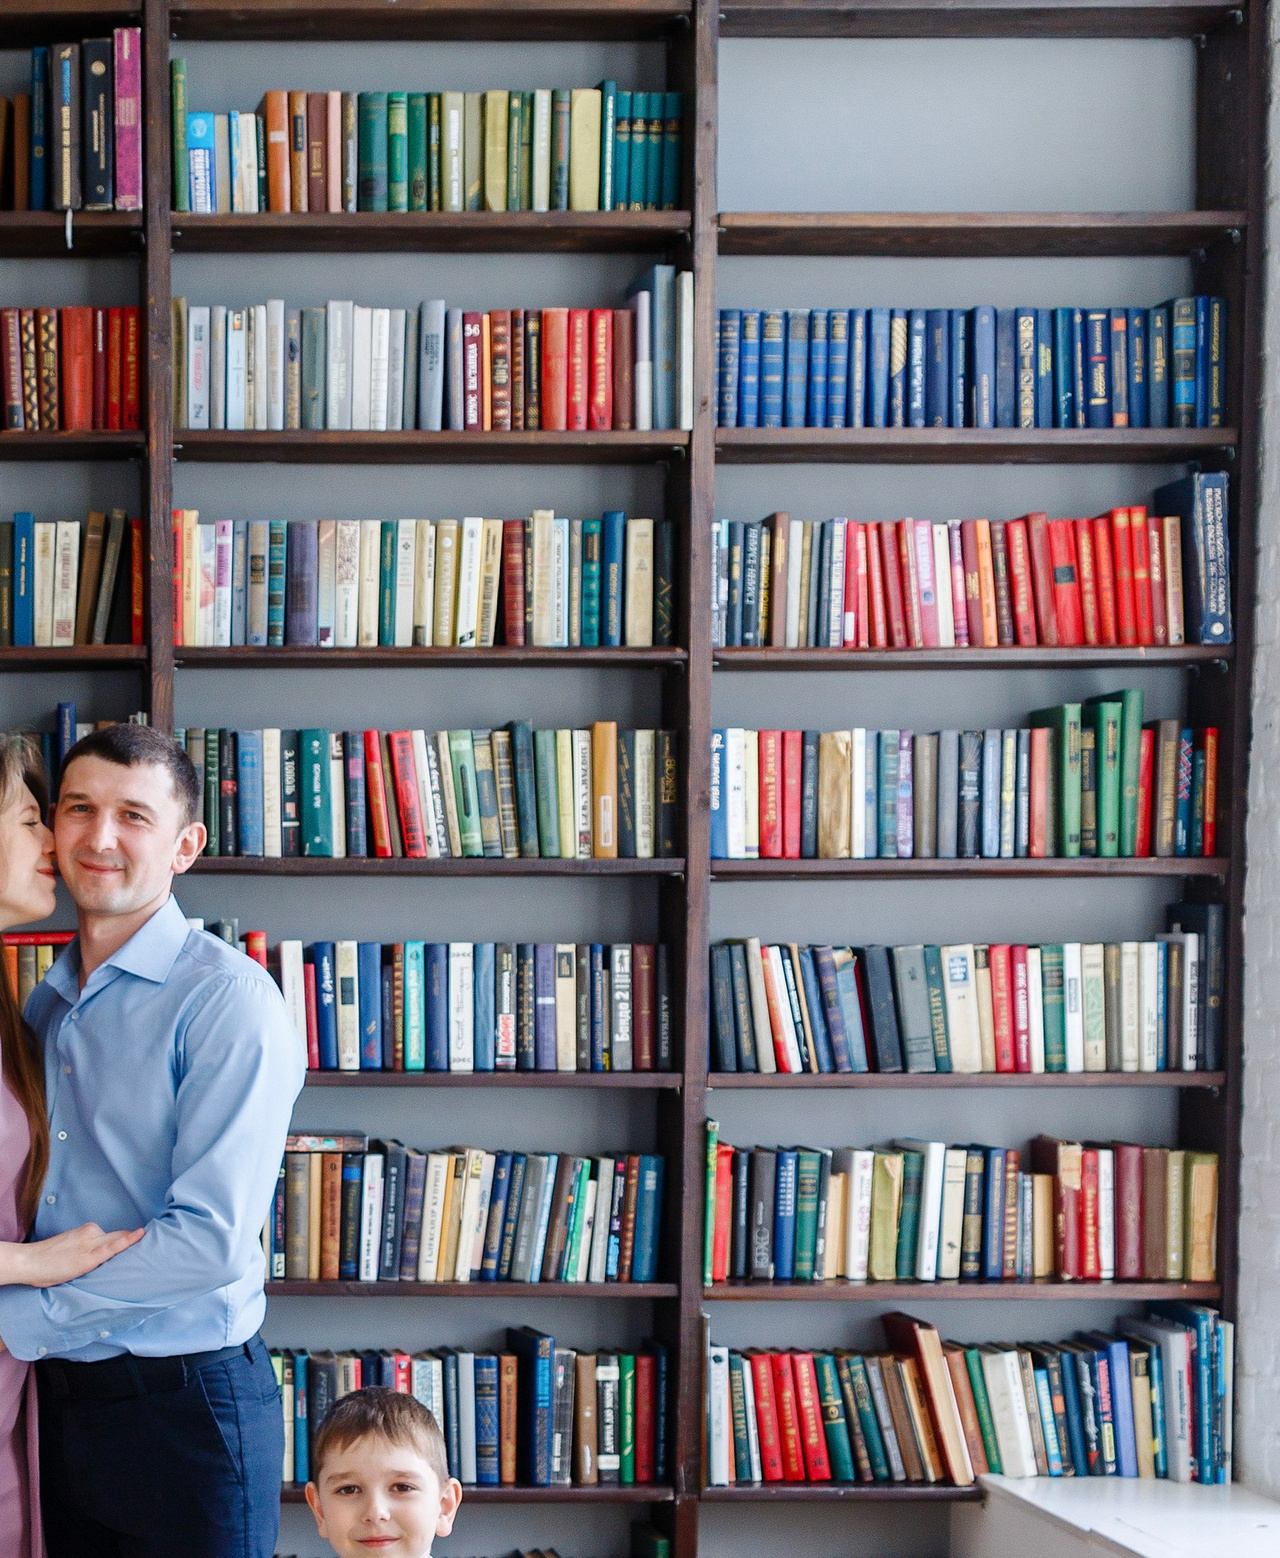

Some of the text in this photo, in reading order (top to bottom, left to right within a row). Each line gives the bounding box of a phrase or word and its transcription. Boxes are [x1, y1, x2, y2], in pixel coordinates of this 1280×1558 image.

[1205, 487, 1217, 614] RUSSIAN-ENGLISH DICTIONARY
[285, 749, 295, 795] Э.ТОПОЛЬ
[615, 991, 631, 1042] Банда 2
